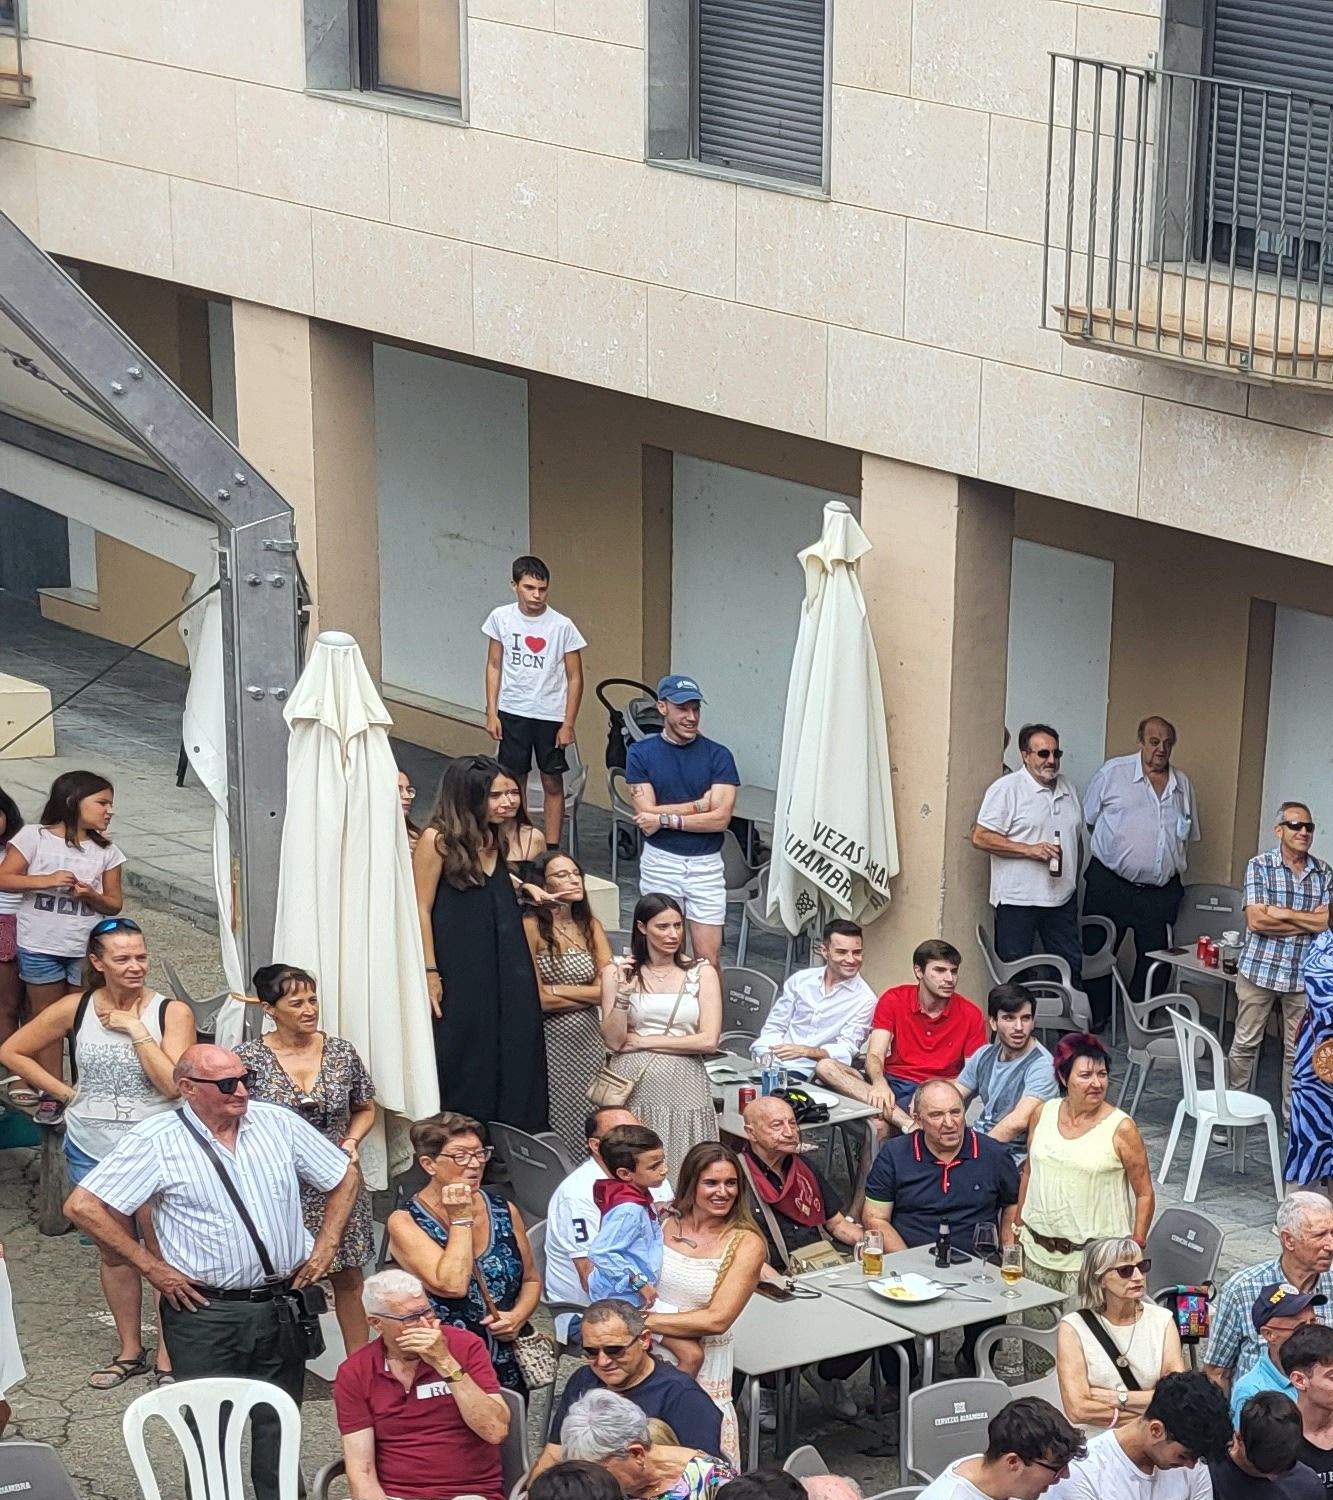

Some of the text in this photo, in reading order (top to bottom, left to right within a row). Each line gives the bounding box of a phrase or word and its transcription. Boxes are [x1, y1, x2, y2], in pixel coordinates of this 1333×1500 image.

[512, 633, 521, 651] I
[511, 652, 545, 669] BCN
[572, 1218, 589, 1243] 3
